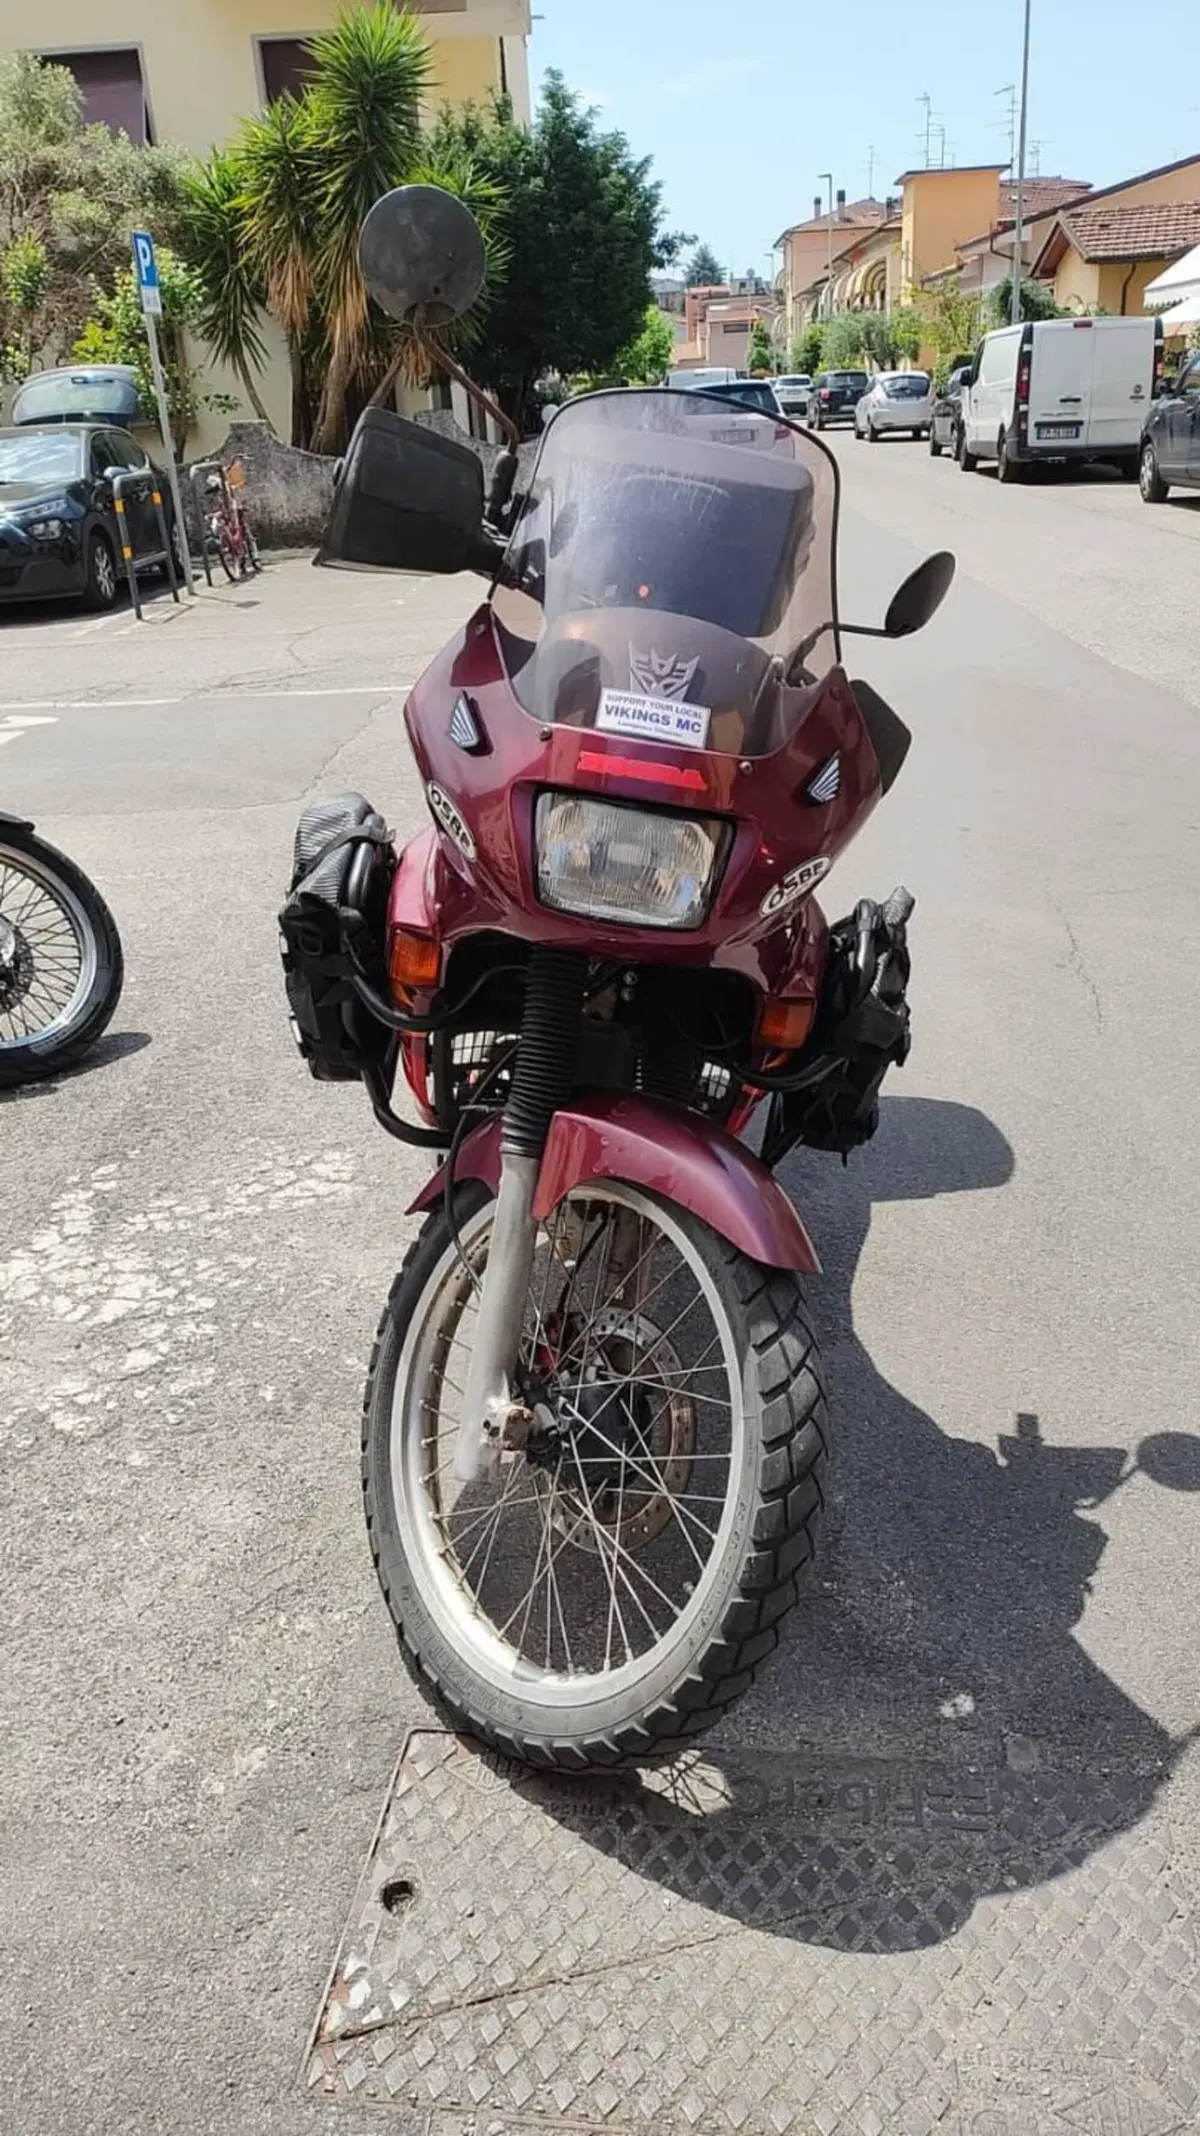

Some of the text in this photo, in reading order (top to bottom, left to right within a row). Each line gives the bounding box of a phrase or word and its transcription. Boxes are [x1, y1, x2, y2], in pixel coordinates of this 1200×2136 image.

[136, 238, 151, 281] P
[605, 704, 670, 727] VIKINGS
[676, 717, 701, 734] MC
[606, 693, 702, 720] SUPPORT YOUR LOCAL
